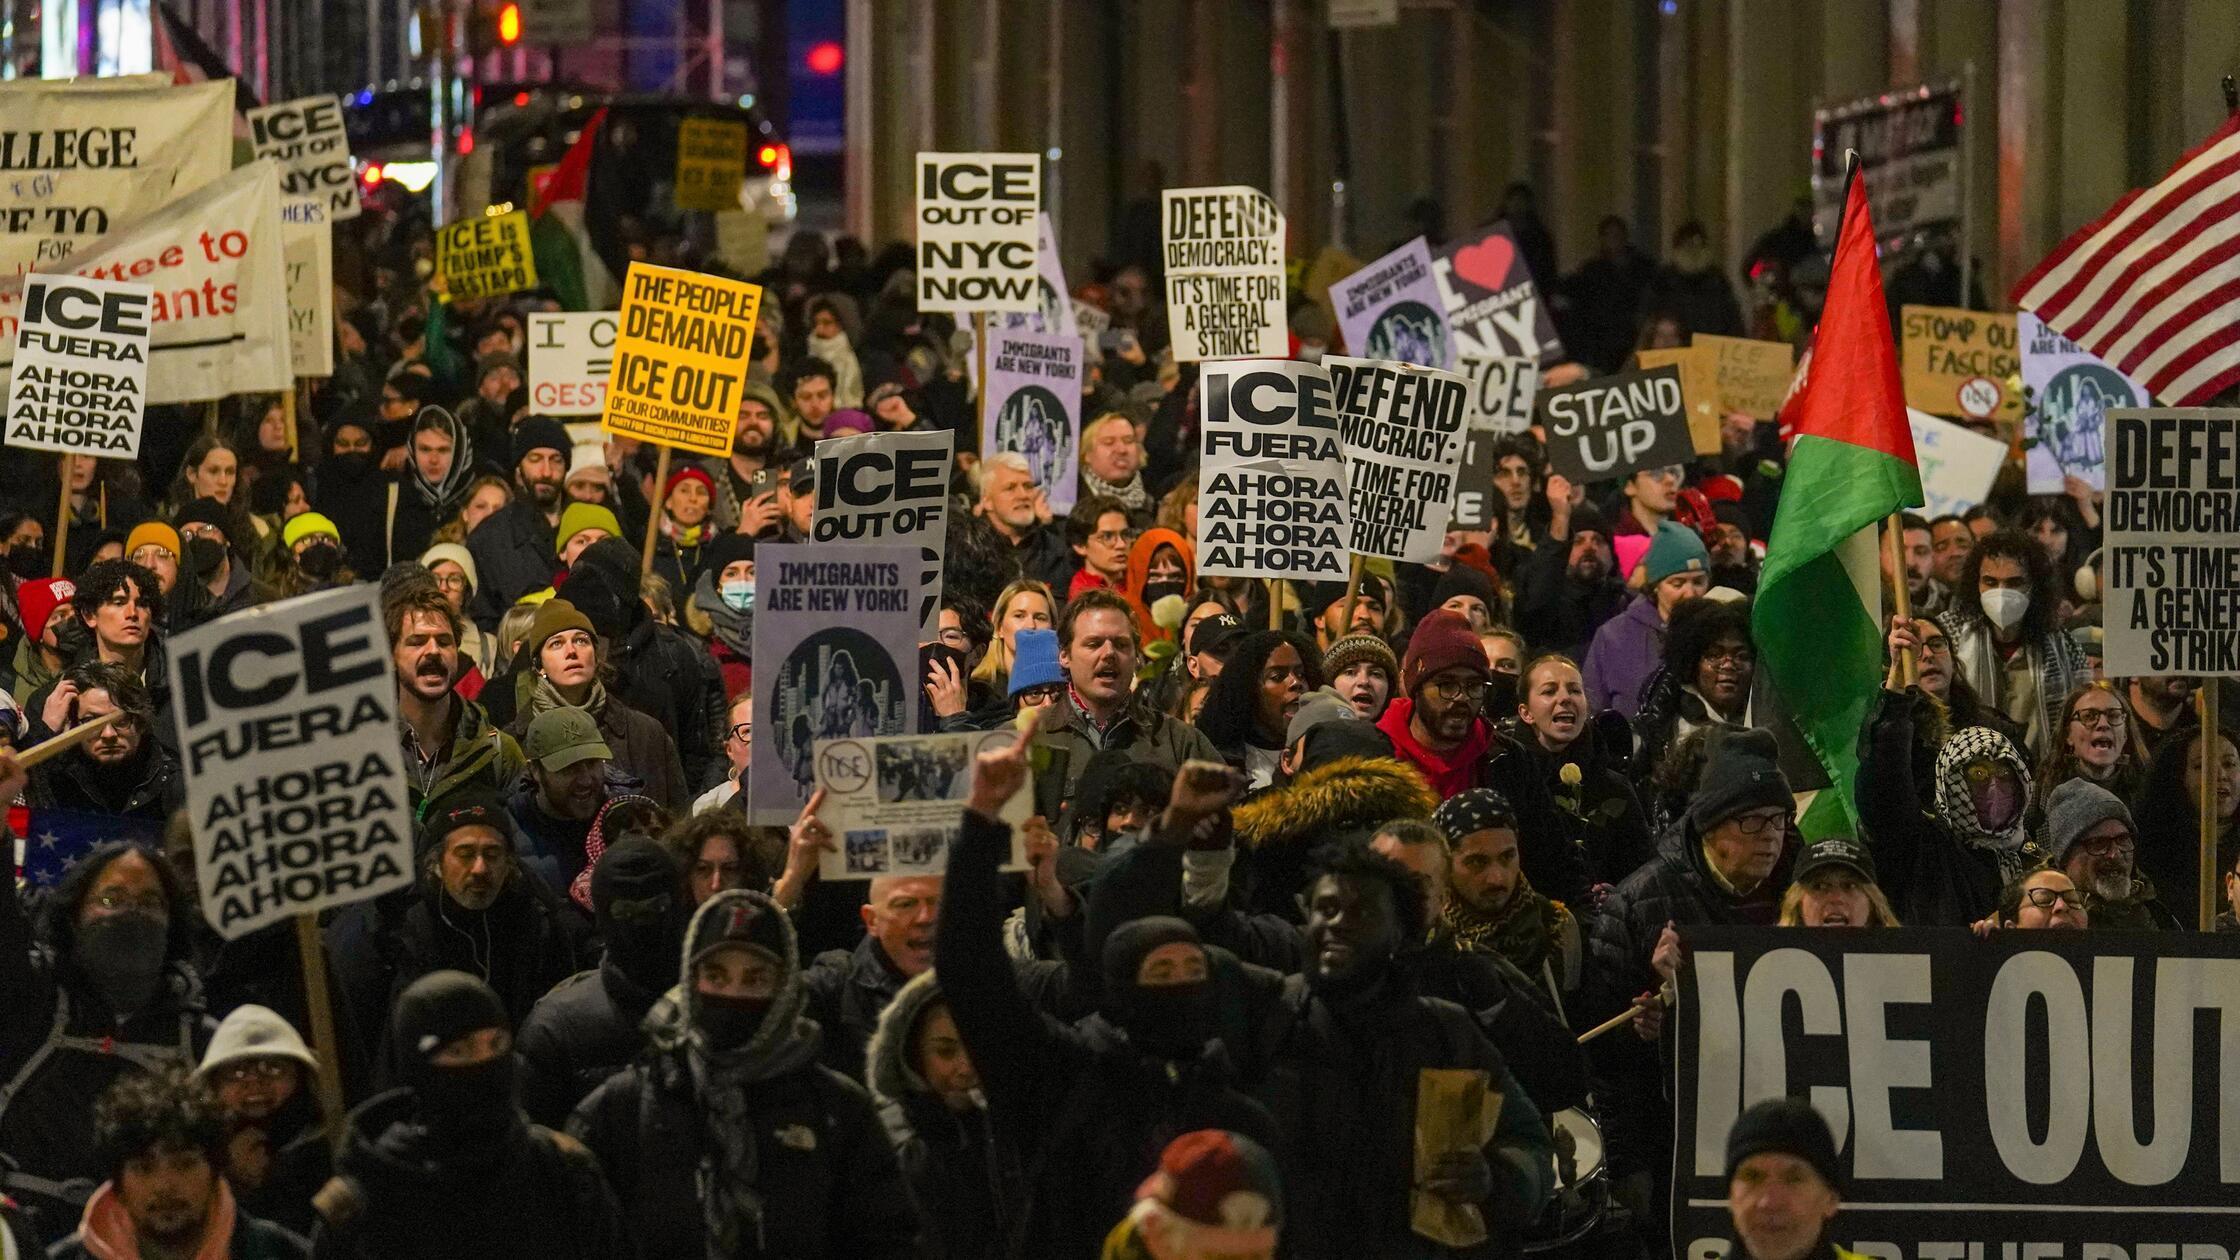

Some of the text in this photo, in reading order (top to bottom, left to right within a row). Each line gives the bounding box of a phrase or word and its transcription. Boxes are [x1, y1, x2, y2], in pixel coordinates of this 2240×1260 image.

[252, 101, 340, 146] ICE
[0, 126, 138, 169] LLEGE
[310, 135, 342, 154] OF
[924, 163, 1035, 201] ICE
[922, 207, 1035, 225] OUT OF
[1170, 194, 1277, 240] DEFEND
[199, 229, 249, 263] to
[445, 220, 493, 251] ICE
[1168, 239, 1277, 268] DEMOCRACY:
[922, 241, 1034, 269] NYC
[634, 273, 754, 321] THE PEOPLE
[923, 277, 1034, 301] NOW
[1173, 275, 1281, 304] IT'S TIME FOR
[24, 283, 148, 337] ICE
[1185, 302, 1270, 331] A GENERAL
[1906, 313, 1976, 343] STOMP
[19, 330, 144, 363] FUERA
[536, 319, 565, 348] I
[625, 303, 747, 360] DEMAND
[1198, 328, 1260, 357] STRIKE!
[2030, 339, 2056, 354] ARE
[995, 356, 1076, 379] ARE NEW YORK!
[1002, 340, 1071, 362] IMMIGRANTS
[17, 364, 139, 394] AHORA
[616, 352, 738, 414] ICE OUT
[13, 403, 135, 432] AHORA
[15, 384, 137, 413] AHORA
[611, 396, 730, 434] OF OUR COMMUNITIES!
[1207, 371, 1338, 431] ICE
[1330, 364, 1467, 433] DEFEND
[1548, 377, 1681, 436] STAND
[11, 422, 132, 451] AHORA
[1205, 431, 1342, 463] FUERA
[1339, 414, 1456, 465] MOCRACY:
[1578, 420, 1656, 471] UP
[2115, 419, 2240, 489] DEFE
[818, 448, 949, 510] ICE
[1206, 473, 1344, 500] AHORA
[1352, 457, 1451, 504] TIME FOR
[814, 505, 943, 542] OUT OF
[1205, 497, 1343, 525] AHORA
[1350, 487, 1426, 531] ENERAL
[1204, 521, 1343, 549] AHORA
[1350, 518, 1409, 557] RIKE!
[779, 562, 899, 586] IMMIGRANTS
[1203, 545, 1342, 573] AHORA
[2112, 546, 2240, 588] IT'S TIME
[768, 588, 908, 611] ARE NEW YORK!
[2130, 588, 2149, 629] A
[178, 604, 385, 728] ICE
[2150, 629, 2240, 672] STRIK
[189, 694, 389, 776] FUERA
[205, 753, 393, 830] AHORA
[209, 784, 396, 864] AHORA
[213, 819, 399, 897] AHORA
[219, 853, 401, 928] AHORA
[1694, 947, 1943, 1180] ICE
